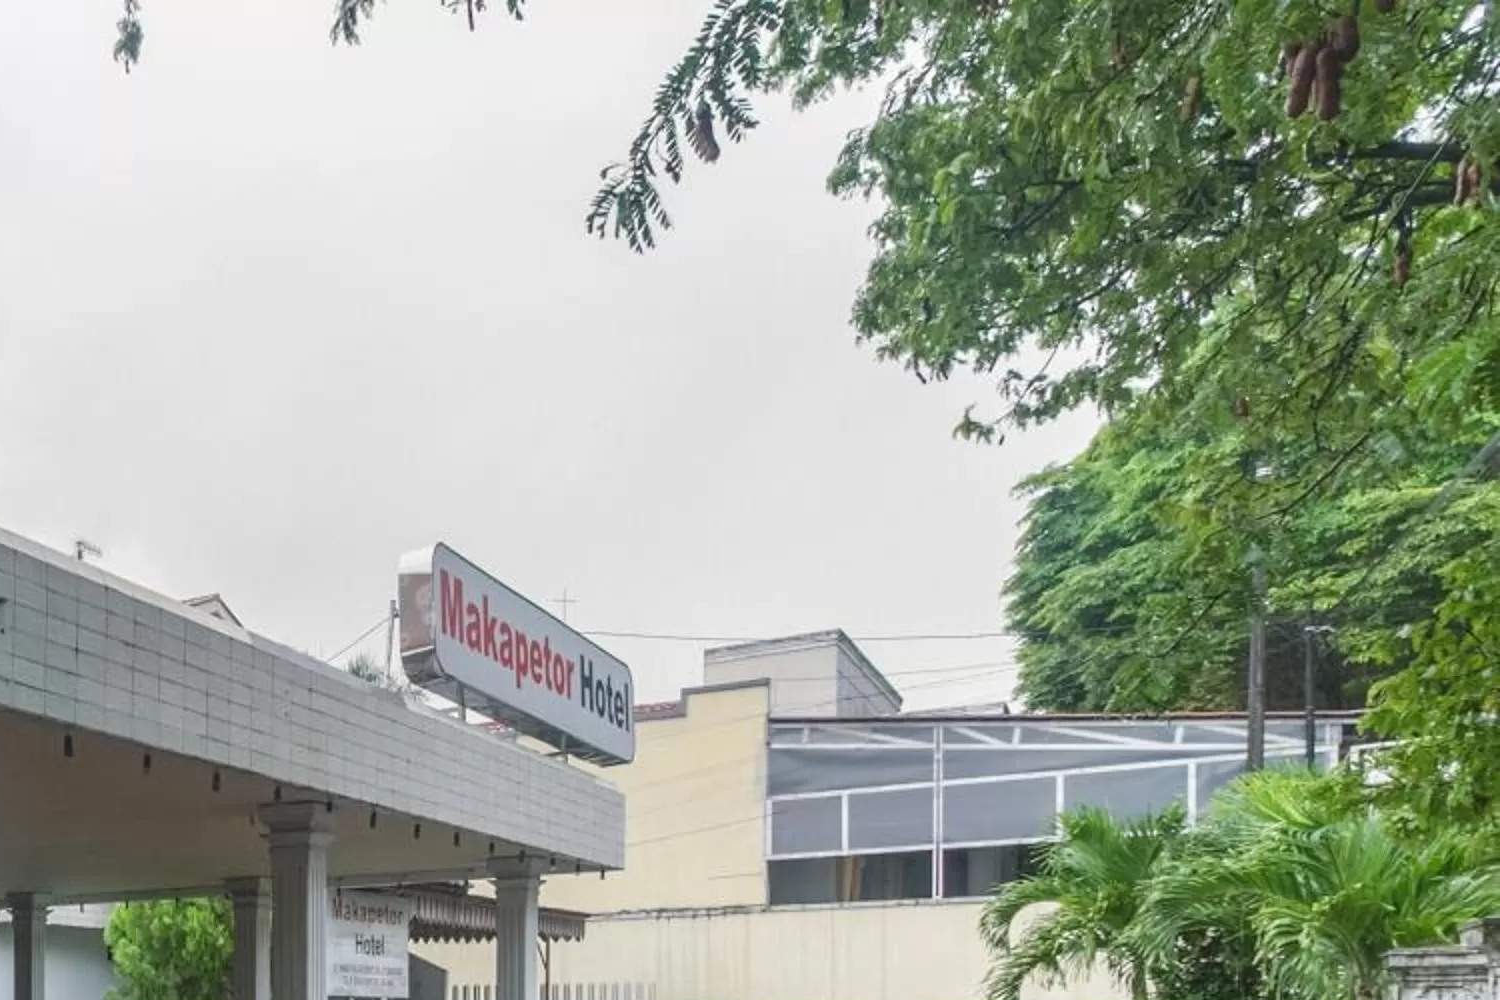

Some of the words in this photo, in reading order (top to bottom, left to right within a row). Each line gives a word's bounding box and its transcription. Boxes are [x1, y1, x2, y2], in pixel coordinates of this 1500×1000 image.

[440, 568, 575, 699] Makapetor
[580, 655, 630, 732] Hotel
[355, 932, 385, 956] Hotel
